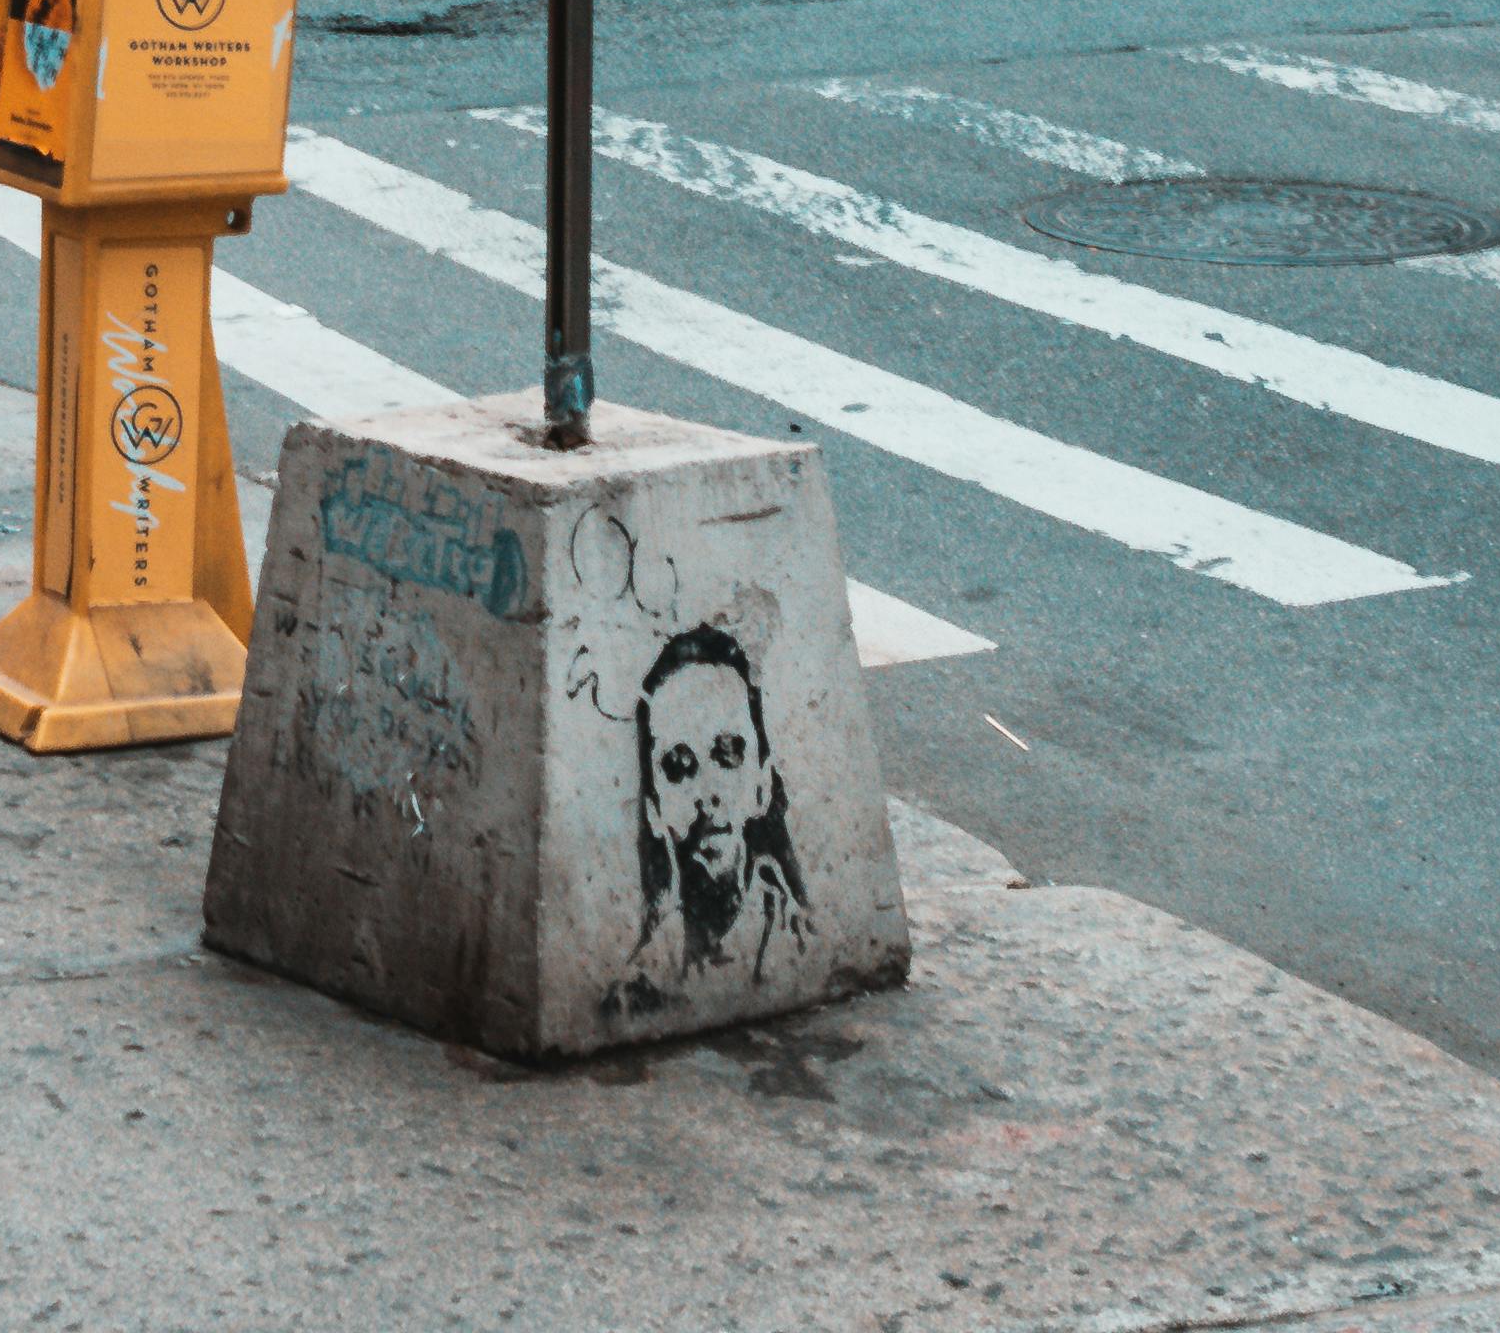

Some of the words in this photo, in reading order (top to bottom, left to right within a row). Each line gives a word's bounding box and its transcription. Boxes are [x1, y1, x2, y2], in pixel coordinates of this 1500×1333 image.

[129, 40, 188, 52] GOTHAM
[193, 41, 251, 53] WRITERS
[152, 55, 228, 67] WORKSHOP
[143, 263, 160, 373] GOTHAM
[133, 475, 152, 588] WRITERS
